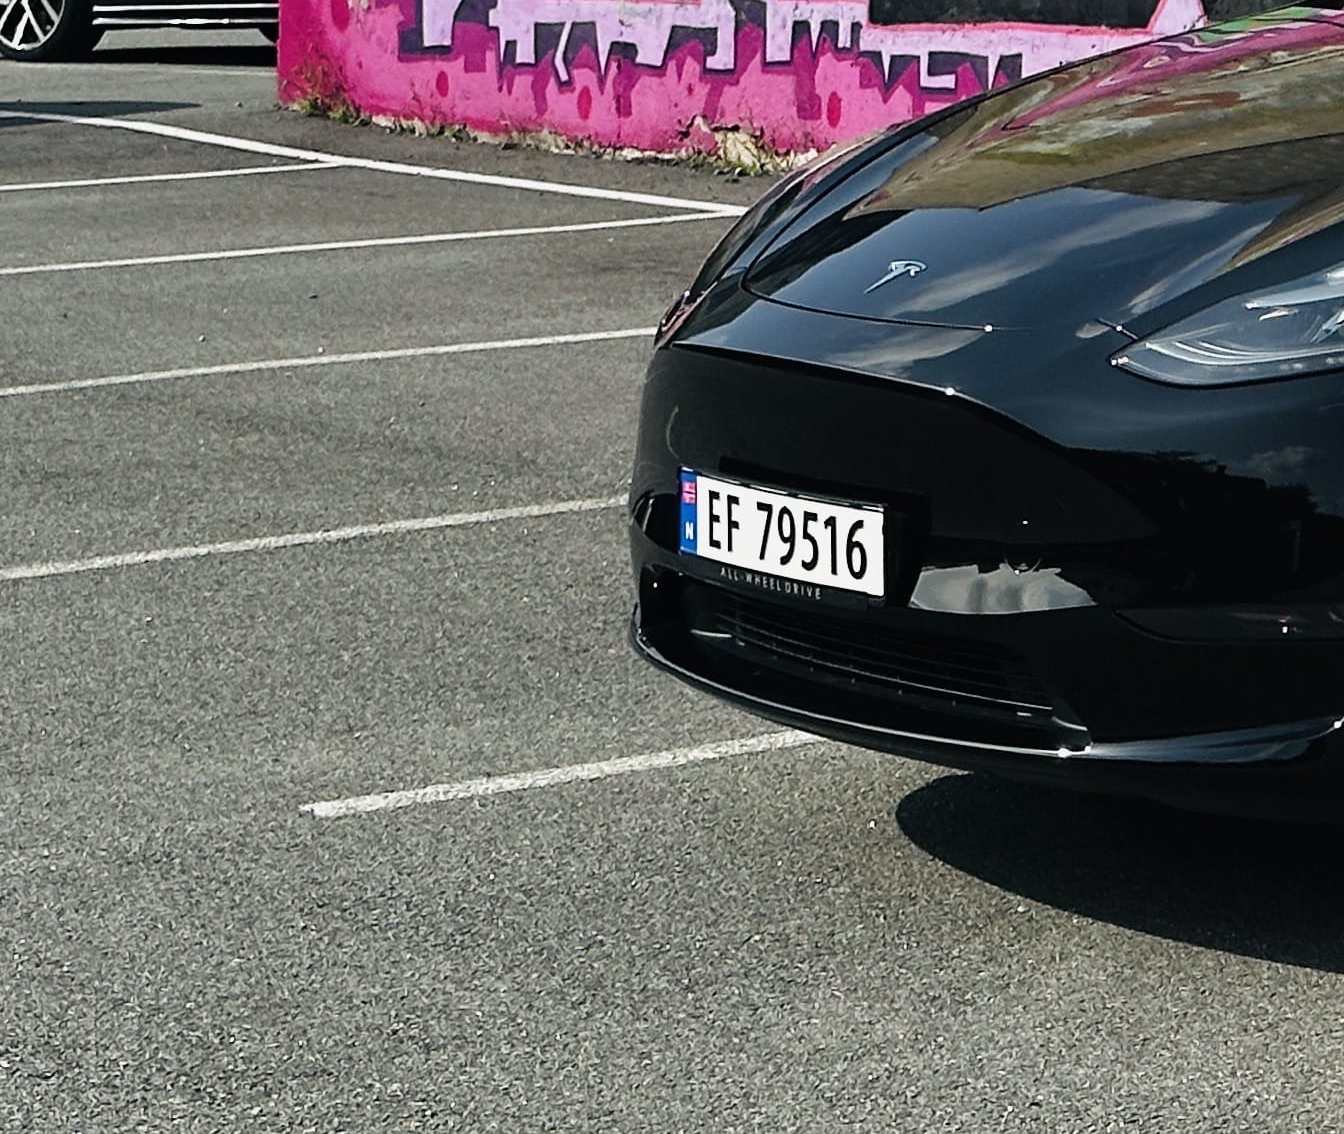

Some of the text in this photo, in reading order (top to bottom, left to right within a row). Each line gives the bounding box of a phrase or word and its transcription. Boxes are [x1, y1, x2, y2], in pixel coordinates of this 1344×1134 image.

[684, 521, 694, 541] N
[708, 489, 868, 580] EF 79516
